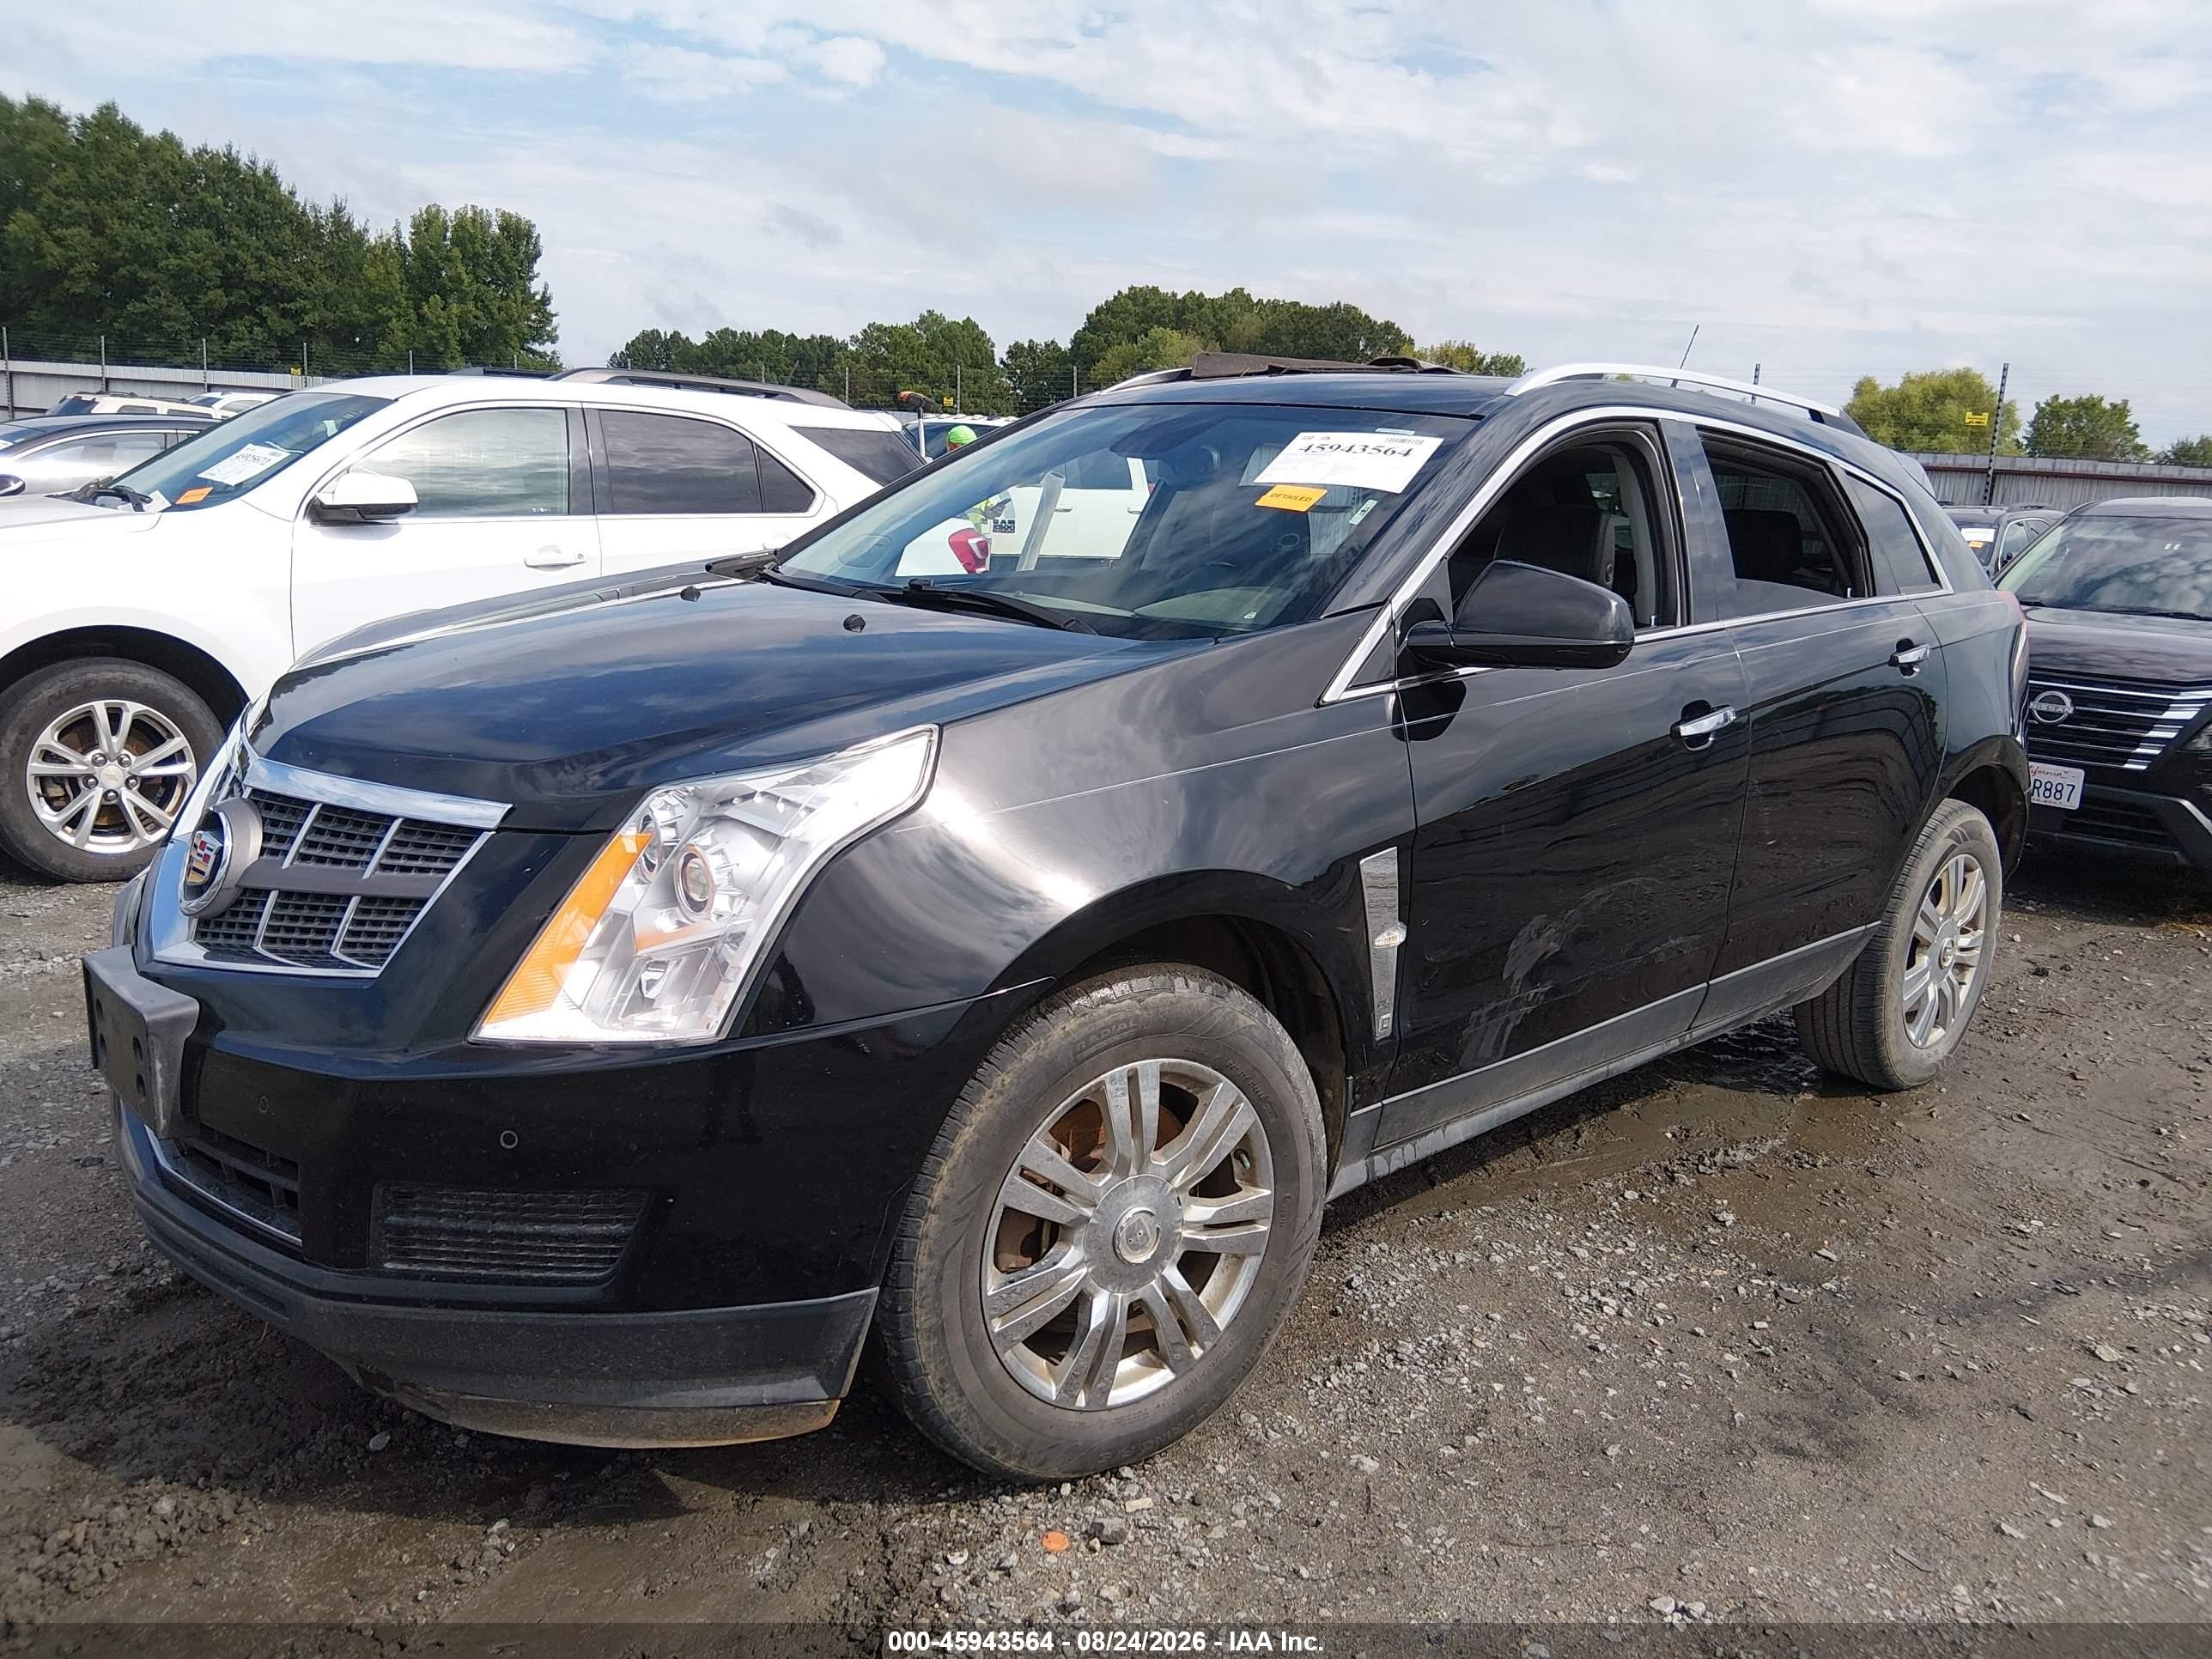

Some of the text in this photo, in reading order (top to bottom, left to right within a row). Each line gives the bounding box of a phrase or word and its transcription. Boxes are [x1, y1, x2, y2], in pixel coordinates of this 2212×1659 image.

[1297, 443, 1413, 457] 45943564
[1269, 492, 1313, 502] DETAILED
[2029, 701, 2075, 714] NISSAN
[2031, 778, 2076, 803] R887
